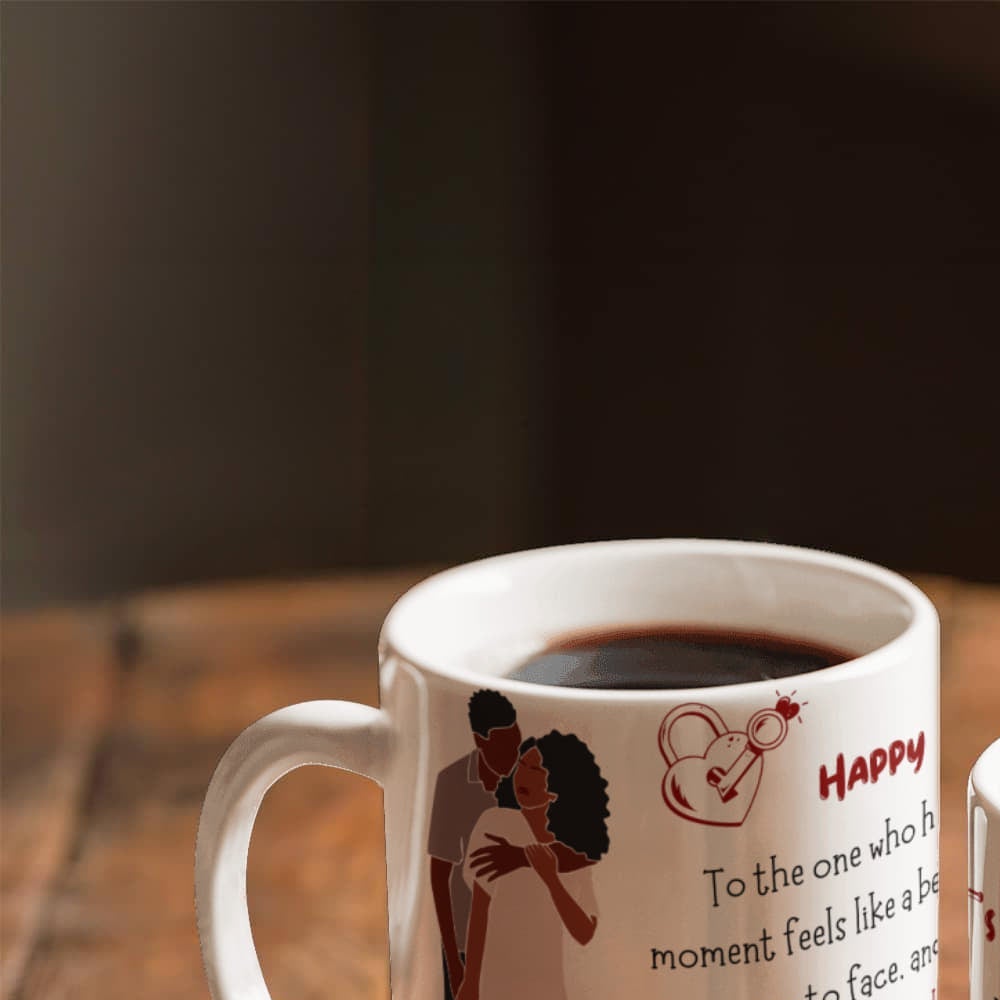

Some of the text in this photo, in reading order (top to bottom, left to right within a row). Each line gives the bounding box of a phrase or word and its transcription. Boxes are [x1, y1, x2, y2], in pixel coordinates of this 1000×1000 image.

[819, 731, 925, 802] HAPPY
[703, 867, 745, 907] To
[752, 855, 804, 896] the
[813, 846, 862, 879] one
[869, 818, 916, 859] who
[651, 928, 776, 970] moment
[783, 906, 847, 956] feels
[854, 892, 896, 935] like
[901, 889, 912, 912] a
